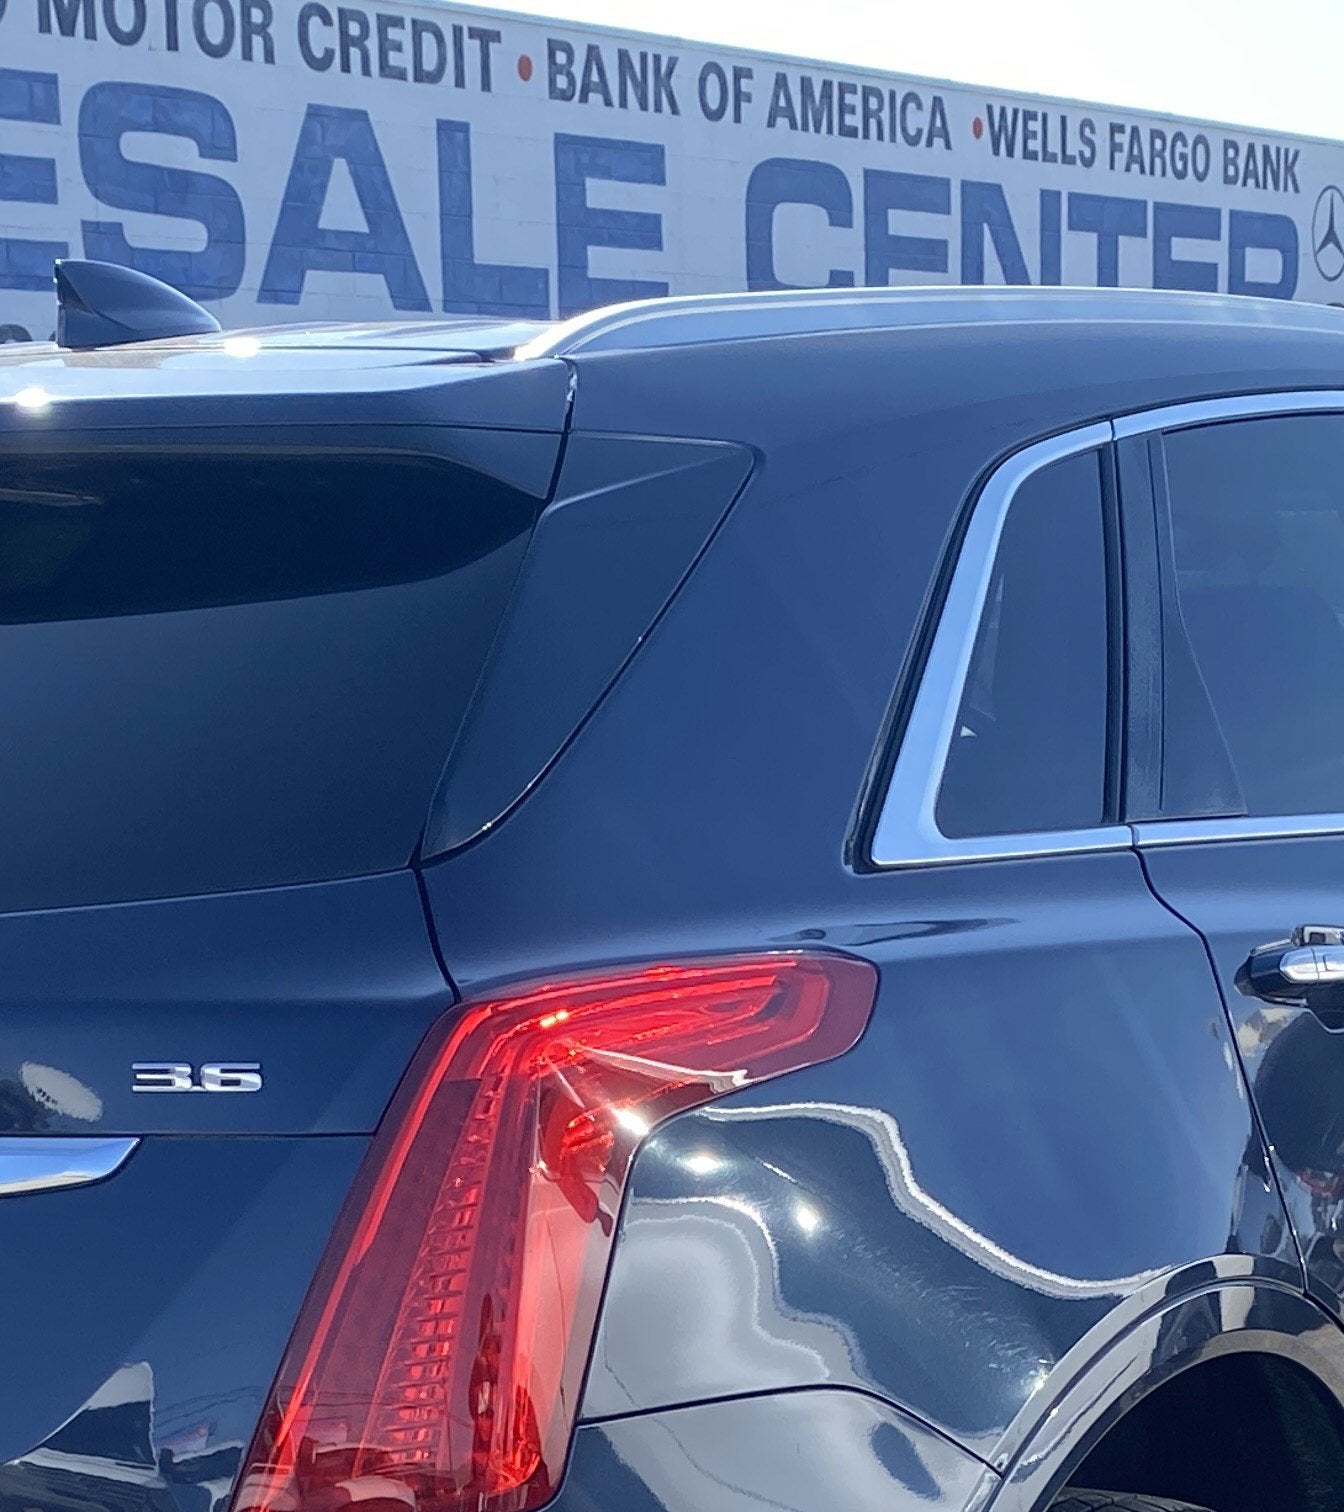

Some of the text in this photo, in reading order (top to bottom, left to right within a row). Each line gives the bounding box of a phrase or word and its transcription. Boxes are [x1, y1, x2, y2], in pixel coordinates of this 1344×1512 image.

[297, 1, 501, 92] CREDIT
[547, 38, 952, 150] BANK OF AMERICA
[986, 103, 1301, 194] WELLS FARGO BANK
[131, 1062, 263, 1092] 3.6
